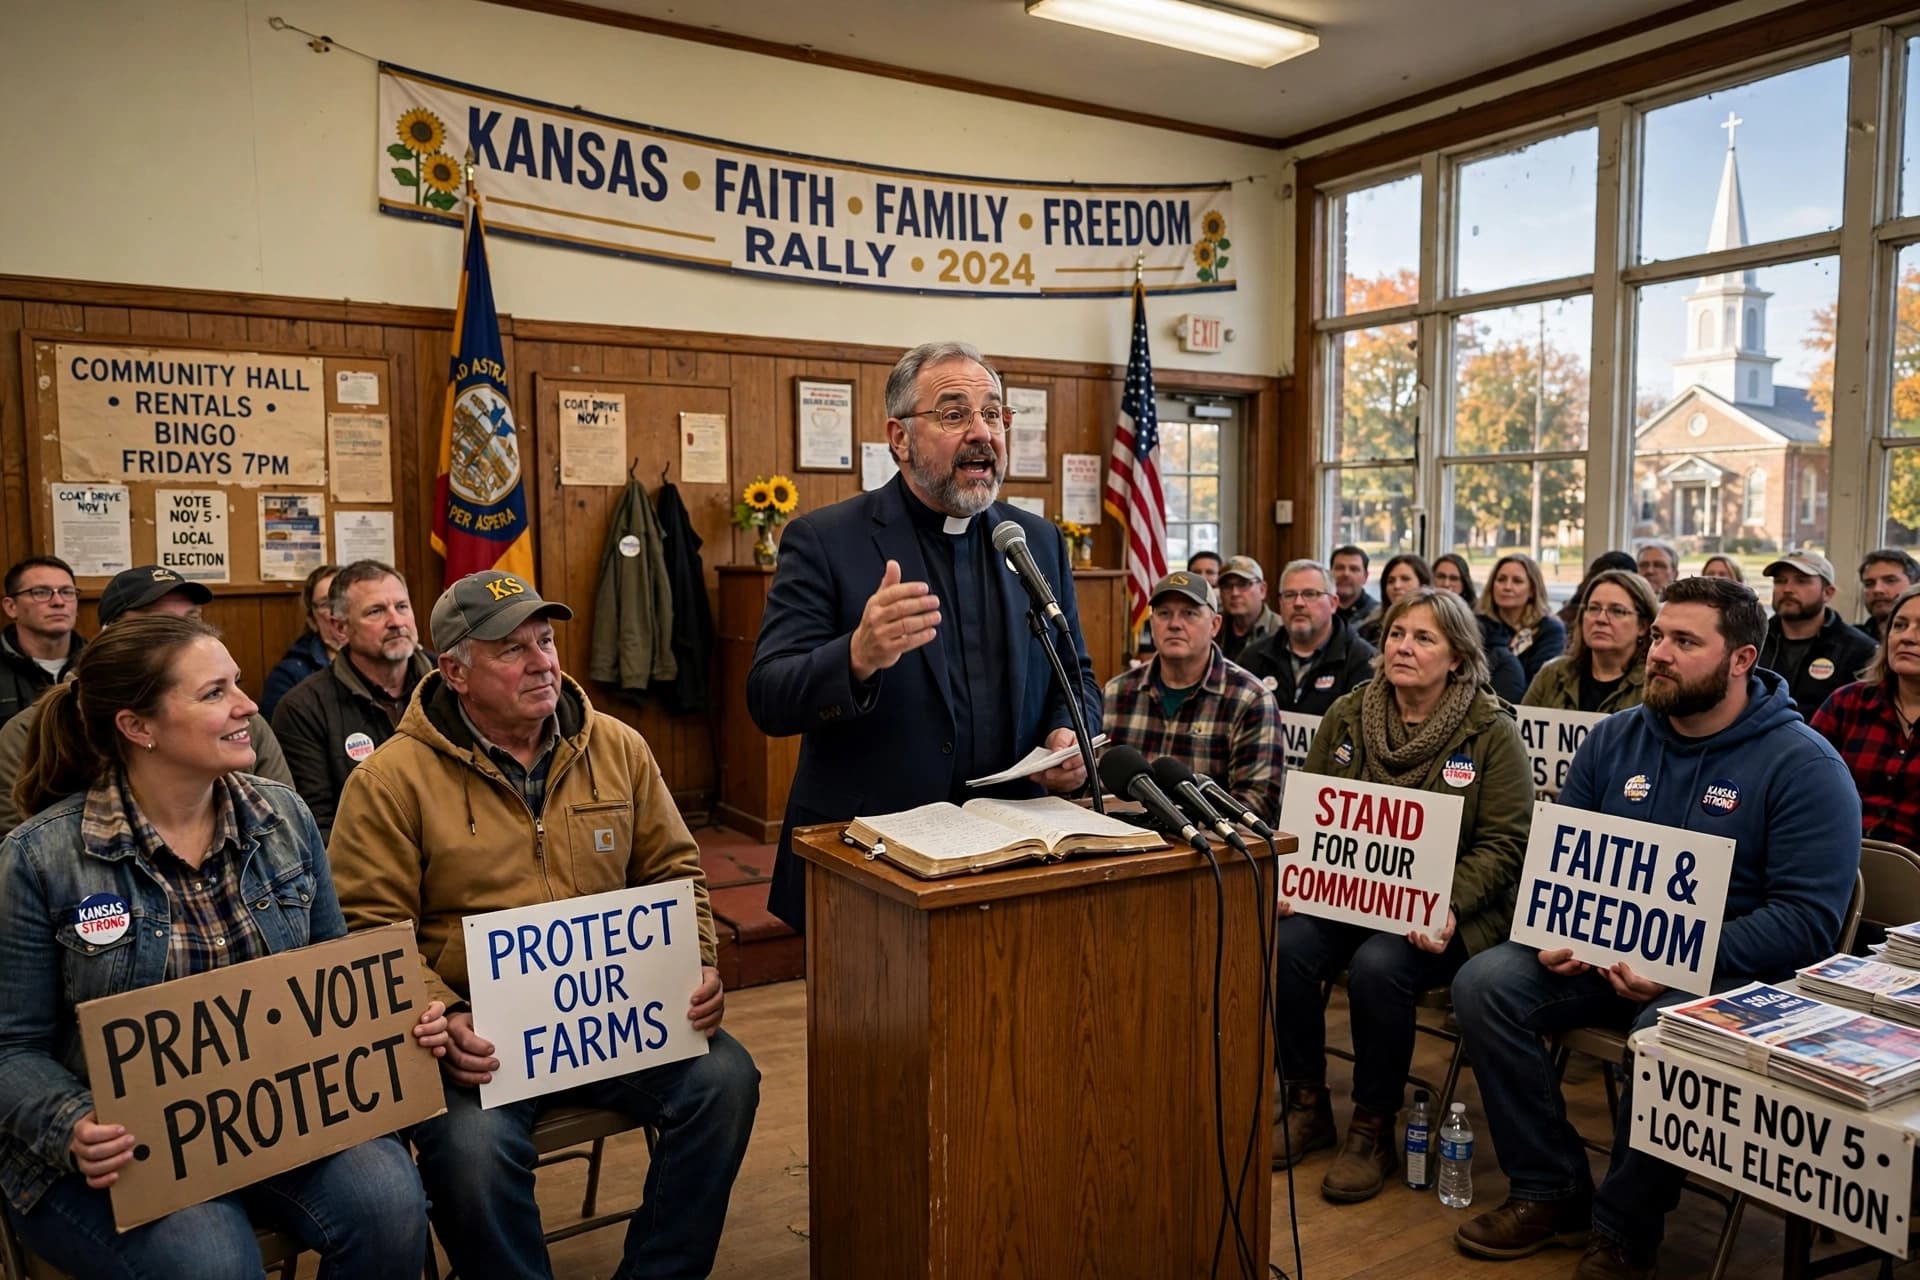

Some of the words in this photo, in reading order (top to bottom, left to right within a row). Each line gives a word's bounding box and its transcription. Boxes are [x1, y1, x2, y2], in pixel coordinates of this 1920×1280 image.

[469, 106, 668, 202] KANSAS
[715, 158, 834, 227] FAITH
[876, 182, 1008, 243] FAMILY
[1043, 198, 1192, 246] FREEDOM
[745, 226, 895, 278] RALLY
[937, 248, 1035, 287] 2024
[1192, 318, 1220, 348] EXIT
[71, 357, 235, 387] COMMUNITY
[247, 367, 310, 391] HALL
[472, 357, 507, 385] ASTRA
[136, 391, 252, 417] RENTALS
[564, 399, 588, 410] COAT
[592, 400, 620, 413] DRIVE
[577, 413, 599, 425] NOV
[604, 413, 609, 425] 1
[155, 421, 236, 446] BINGO
[122, 450, 232, 475] FRIDAYS
[242, 453, 289, 475] 7PM
[59, 491, 86, 501] COAT
[91, 492, 121, 502] DRIVE
[78, 503, 99, 512] NOV
[173, 496, 211, 508] VOTE
[170, 510, 199, 522] NOV
[203, 511, 212, 522] 5
[449, 508, 472, 526] PER
[475, 508, 516, 531] ASPERA
[172, 532, 213, 545] LOCAL
[163, 553, 224, 566] ELECTION
[486, 577, 525, 601] KS
[1702, 795, 1735, 809] STRONG
[1707, 785, 1737, 799] KANSAS
[1315, 787, 1424, 841] STAND
[1311, 832, 1358, 869] FOR
[1365, 841, 1415, 879] OUR
[1550, 824, 1659, 895] FAITH
[1666, 851, 1699, 905] &
[1281, 864, 1440, 927] COMMUNITY
[78, 902, 124, 922] KANSAS
[82, 916, 125, 934] STRONG
[1526, 878, 1706, 973] FREEDOM
[488, 899, 677, 980] PROTECT
[554, 964, 629, 1013] OUR
[102, 989, 251, 1099] PRAY
[287, 949, 413, 1037] VOTE
[523, 1001, 668, 1079] FARMS
[163, 1034, 404, 1181] PROTECT
[1657, 1060, 1741, 1127] VOTE
[1754, 1094, 1831, 1157] NOV
[1842, 1125, 1865, 1170] 5
[1649, 1106, 1732, 1173] LOCAL
[1742, 1140, 1888, 1236] ELECTION
